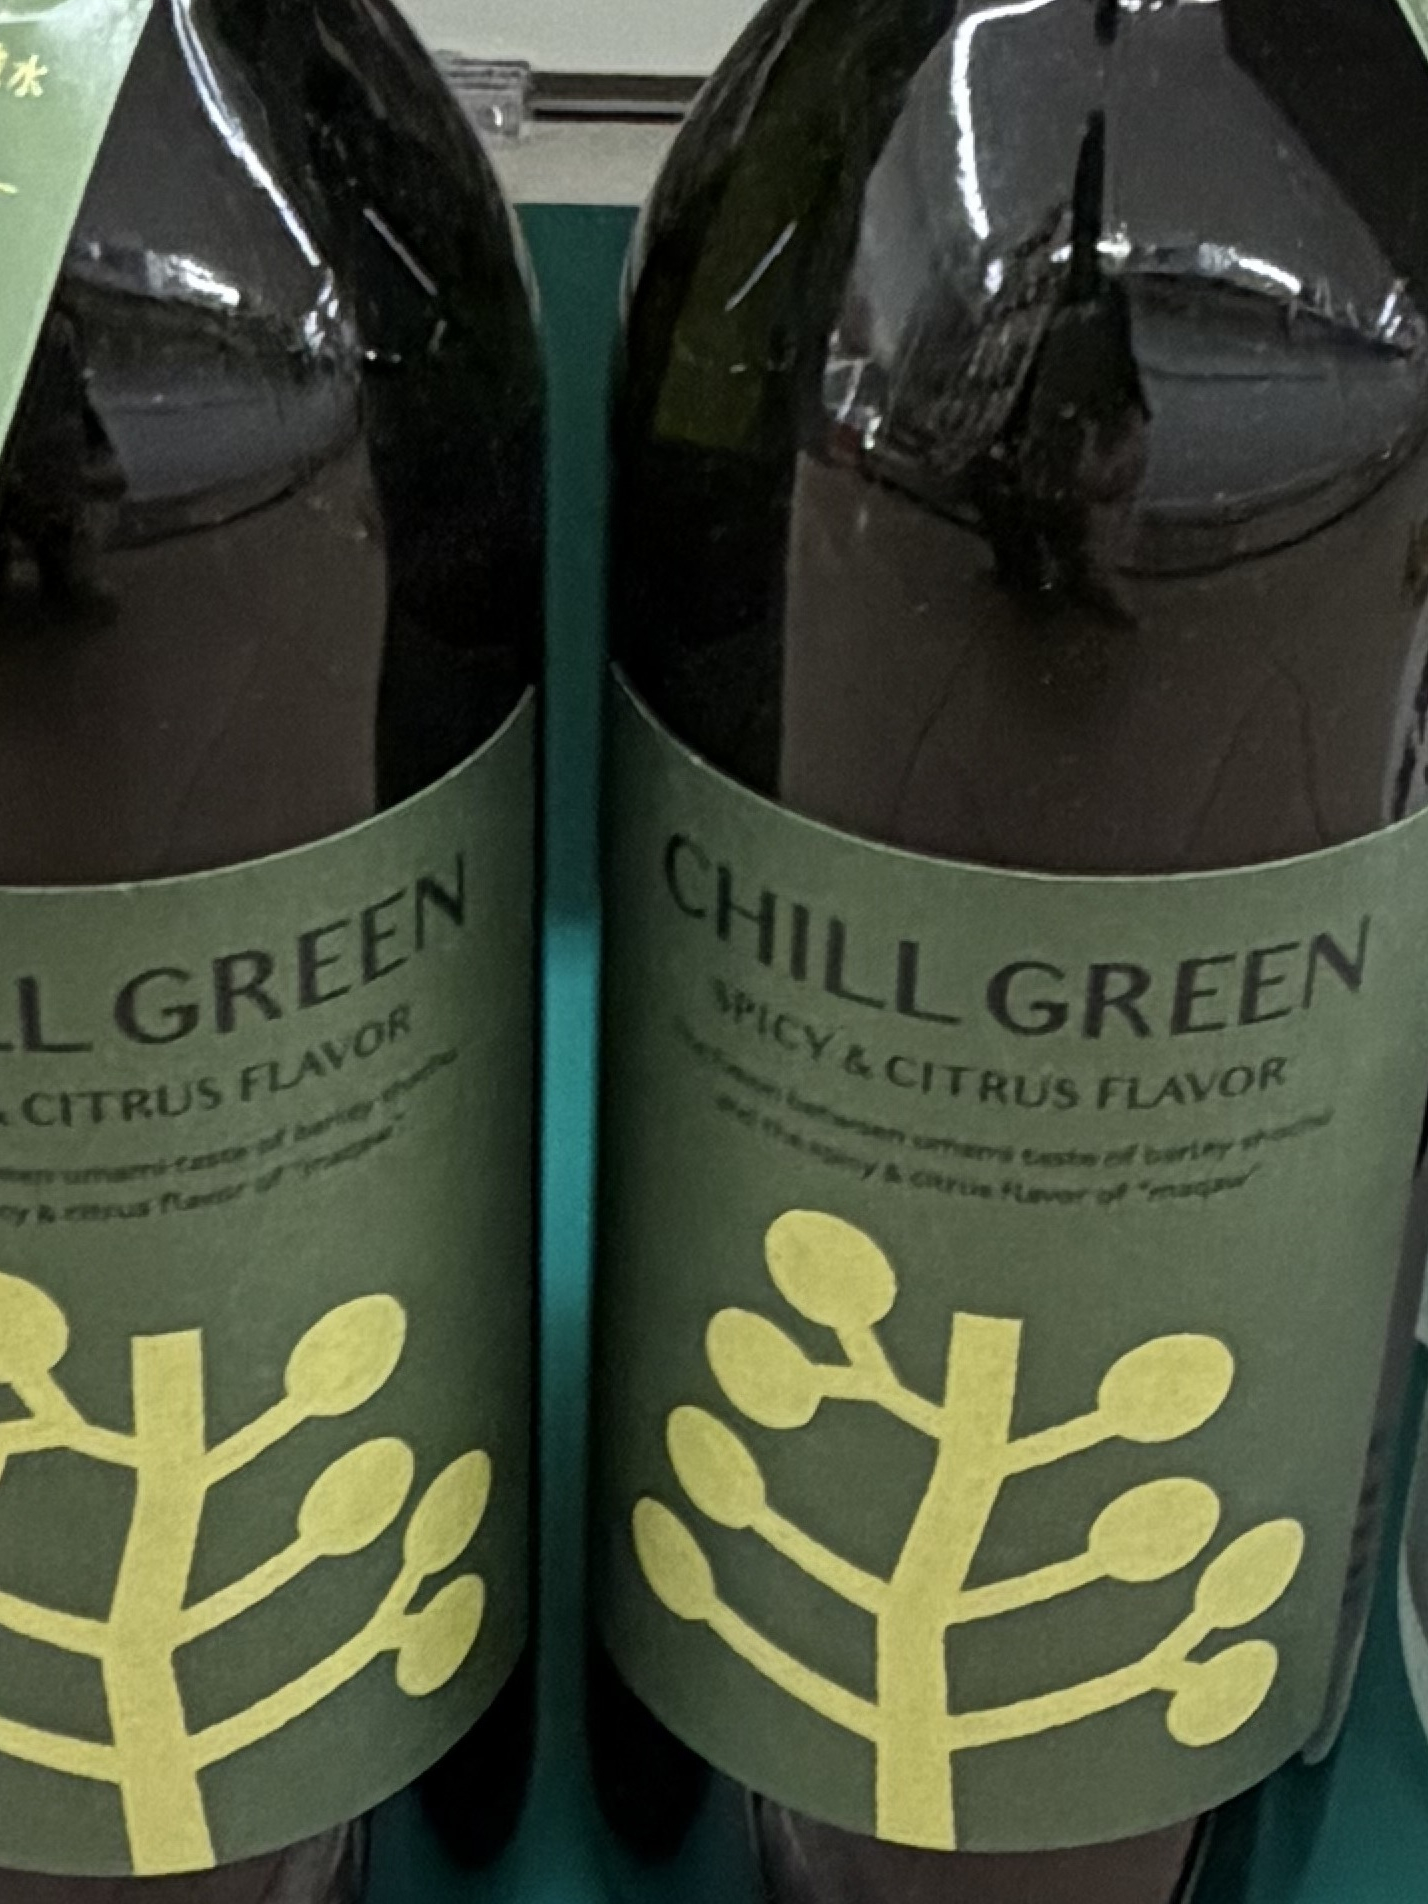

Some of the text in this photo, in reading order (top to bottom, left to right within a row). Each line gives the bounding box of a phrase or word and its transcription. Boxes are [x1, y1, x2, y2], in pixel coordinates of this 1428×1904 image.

[111, 853, 467, 1048] GREEN
[662, 830, 1373, 1040] CHILL GREEN
[23, 1075, 222, 1128] CITRUS
[239, 1001, 412, 1102] FLAVOR
[884, 1053, 1079, 1111] CITRUS
[1096, 1056, 1288, 1110] FLAVOR
